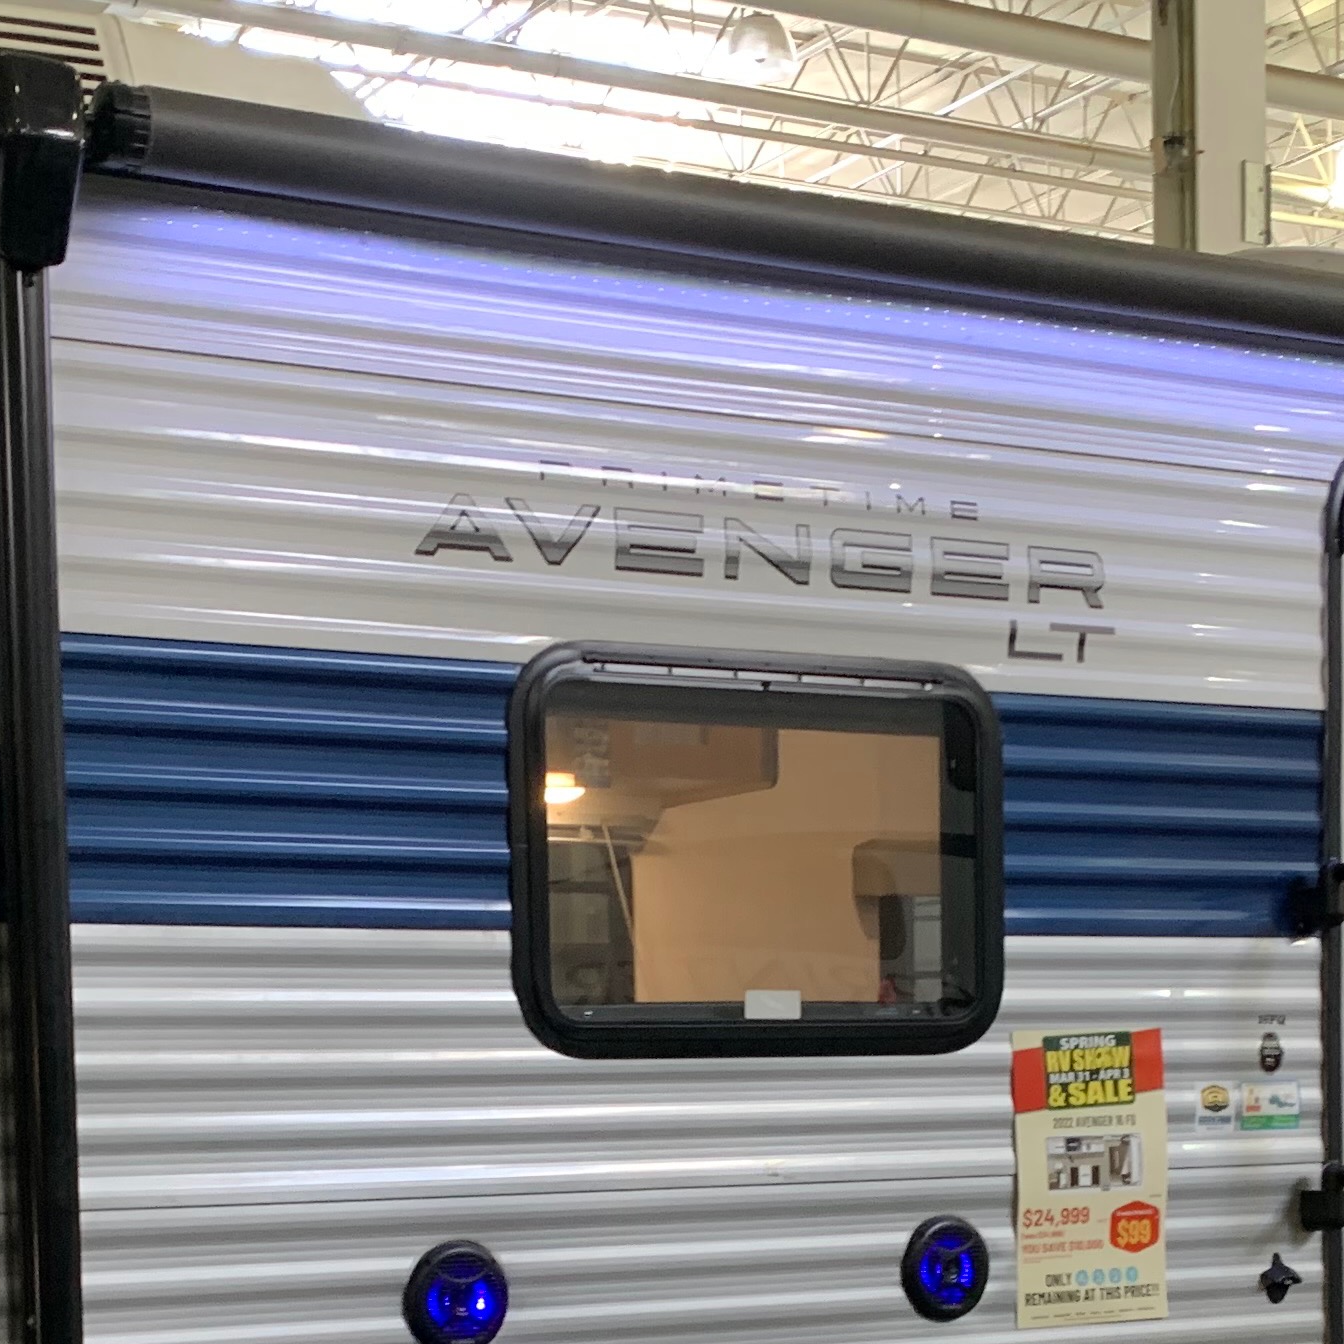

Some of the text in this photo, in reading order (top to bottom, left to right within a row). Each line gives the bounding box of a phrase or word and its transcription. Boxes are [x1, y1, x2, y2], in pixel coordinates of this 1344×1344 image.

[413, 492, 1106, 610] AVENGER
[1007, 619, 1116, 664] LT
[1059, 1034, 1116, 1050] SPRING
[1047, 1045, 1131, 1073] RV SHOW
[1048, 1078, 1133, 1107] & SALE
[1022, 1206, 1090, 1230] $24,999
[1117, 1219, 1152, 1247] $99
[1025, 1289, 1081, 1307] REMAINING
[1083, 1287, 1097, 1303] AT
[1099, 1285, 1122, 1301] THIS
